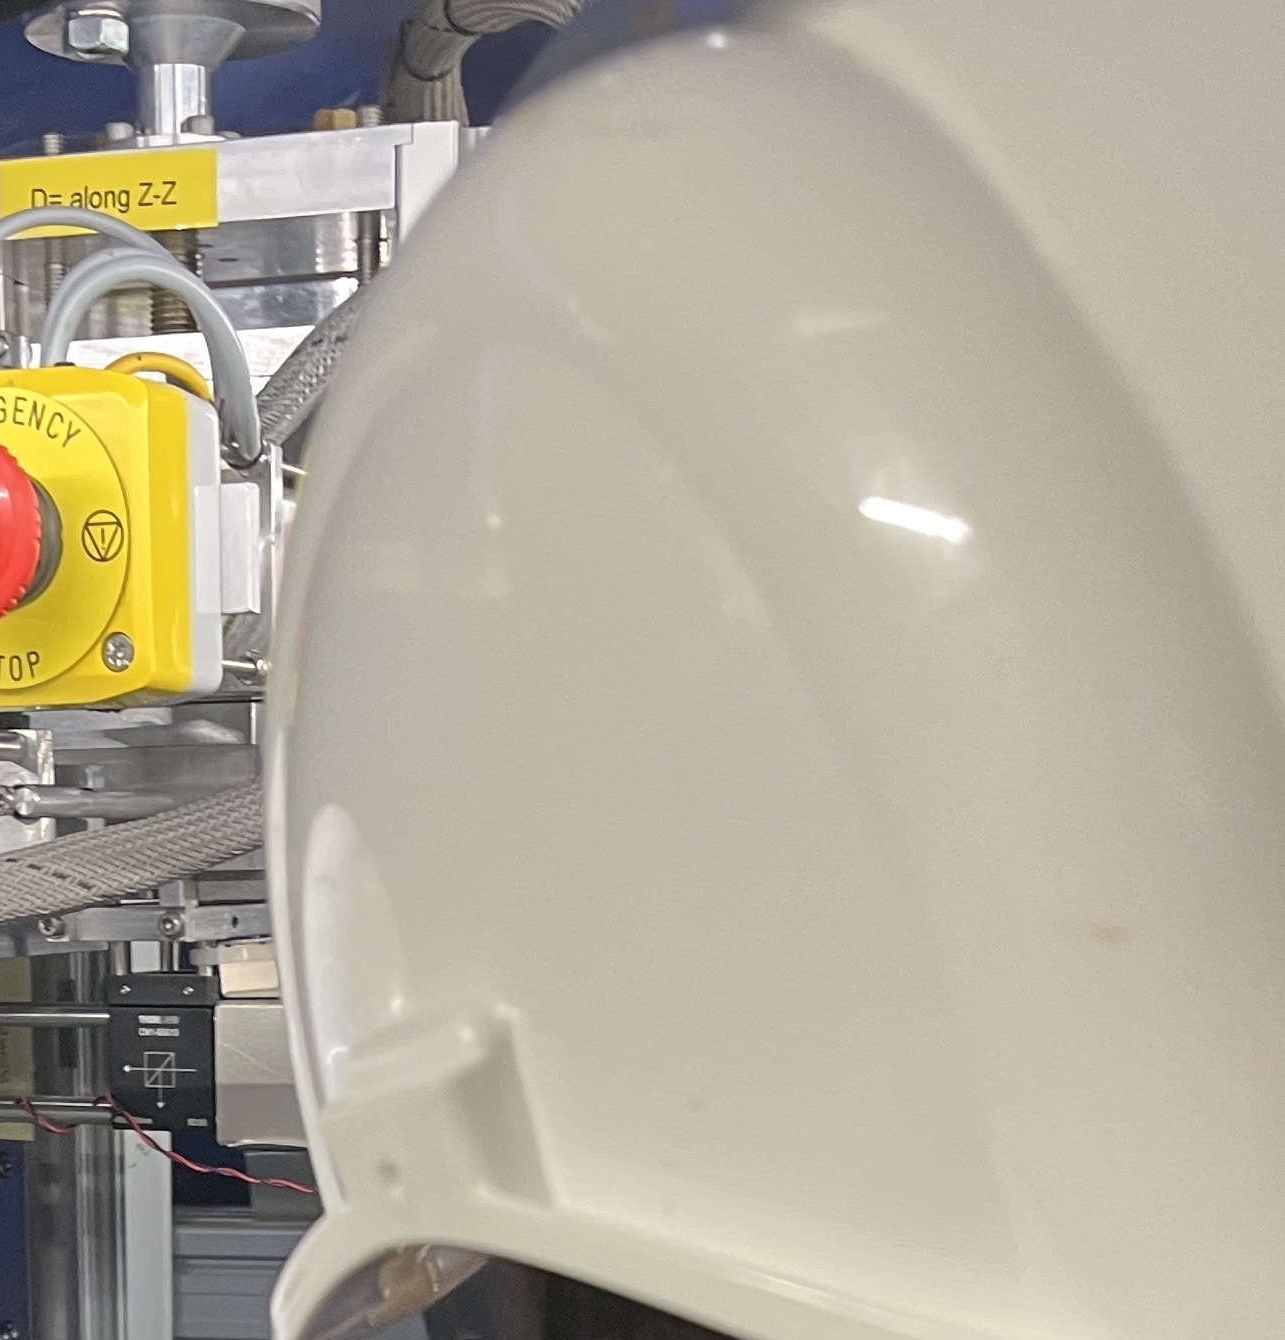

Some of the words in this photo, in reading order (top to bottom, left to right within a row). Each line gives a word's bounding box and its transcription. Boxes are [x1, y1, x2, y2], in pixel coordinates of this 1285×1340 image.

[30, 187, 63, 209] D=
[70, 185, 131, 214] along
[138, 180, 178, 207] Z-Z
